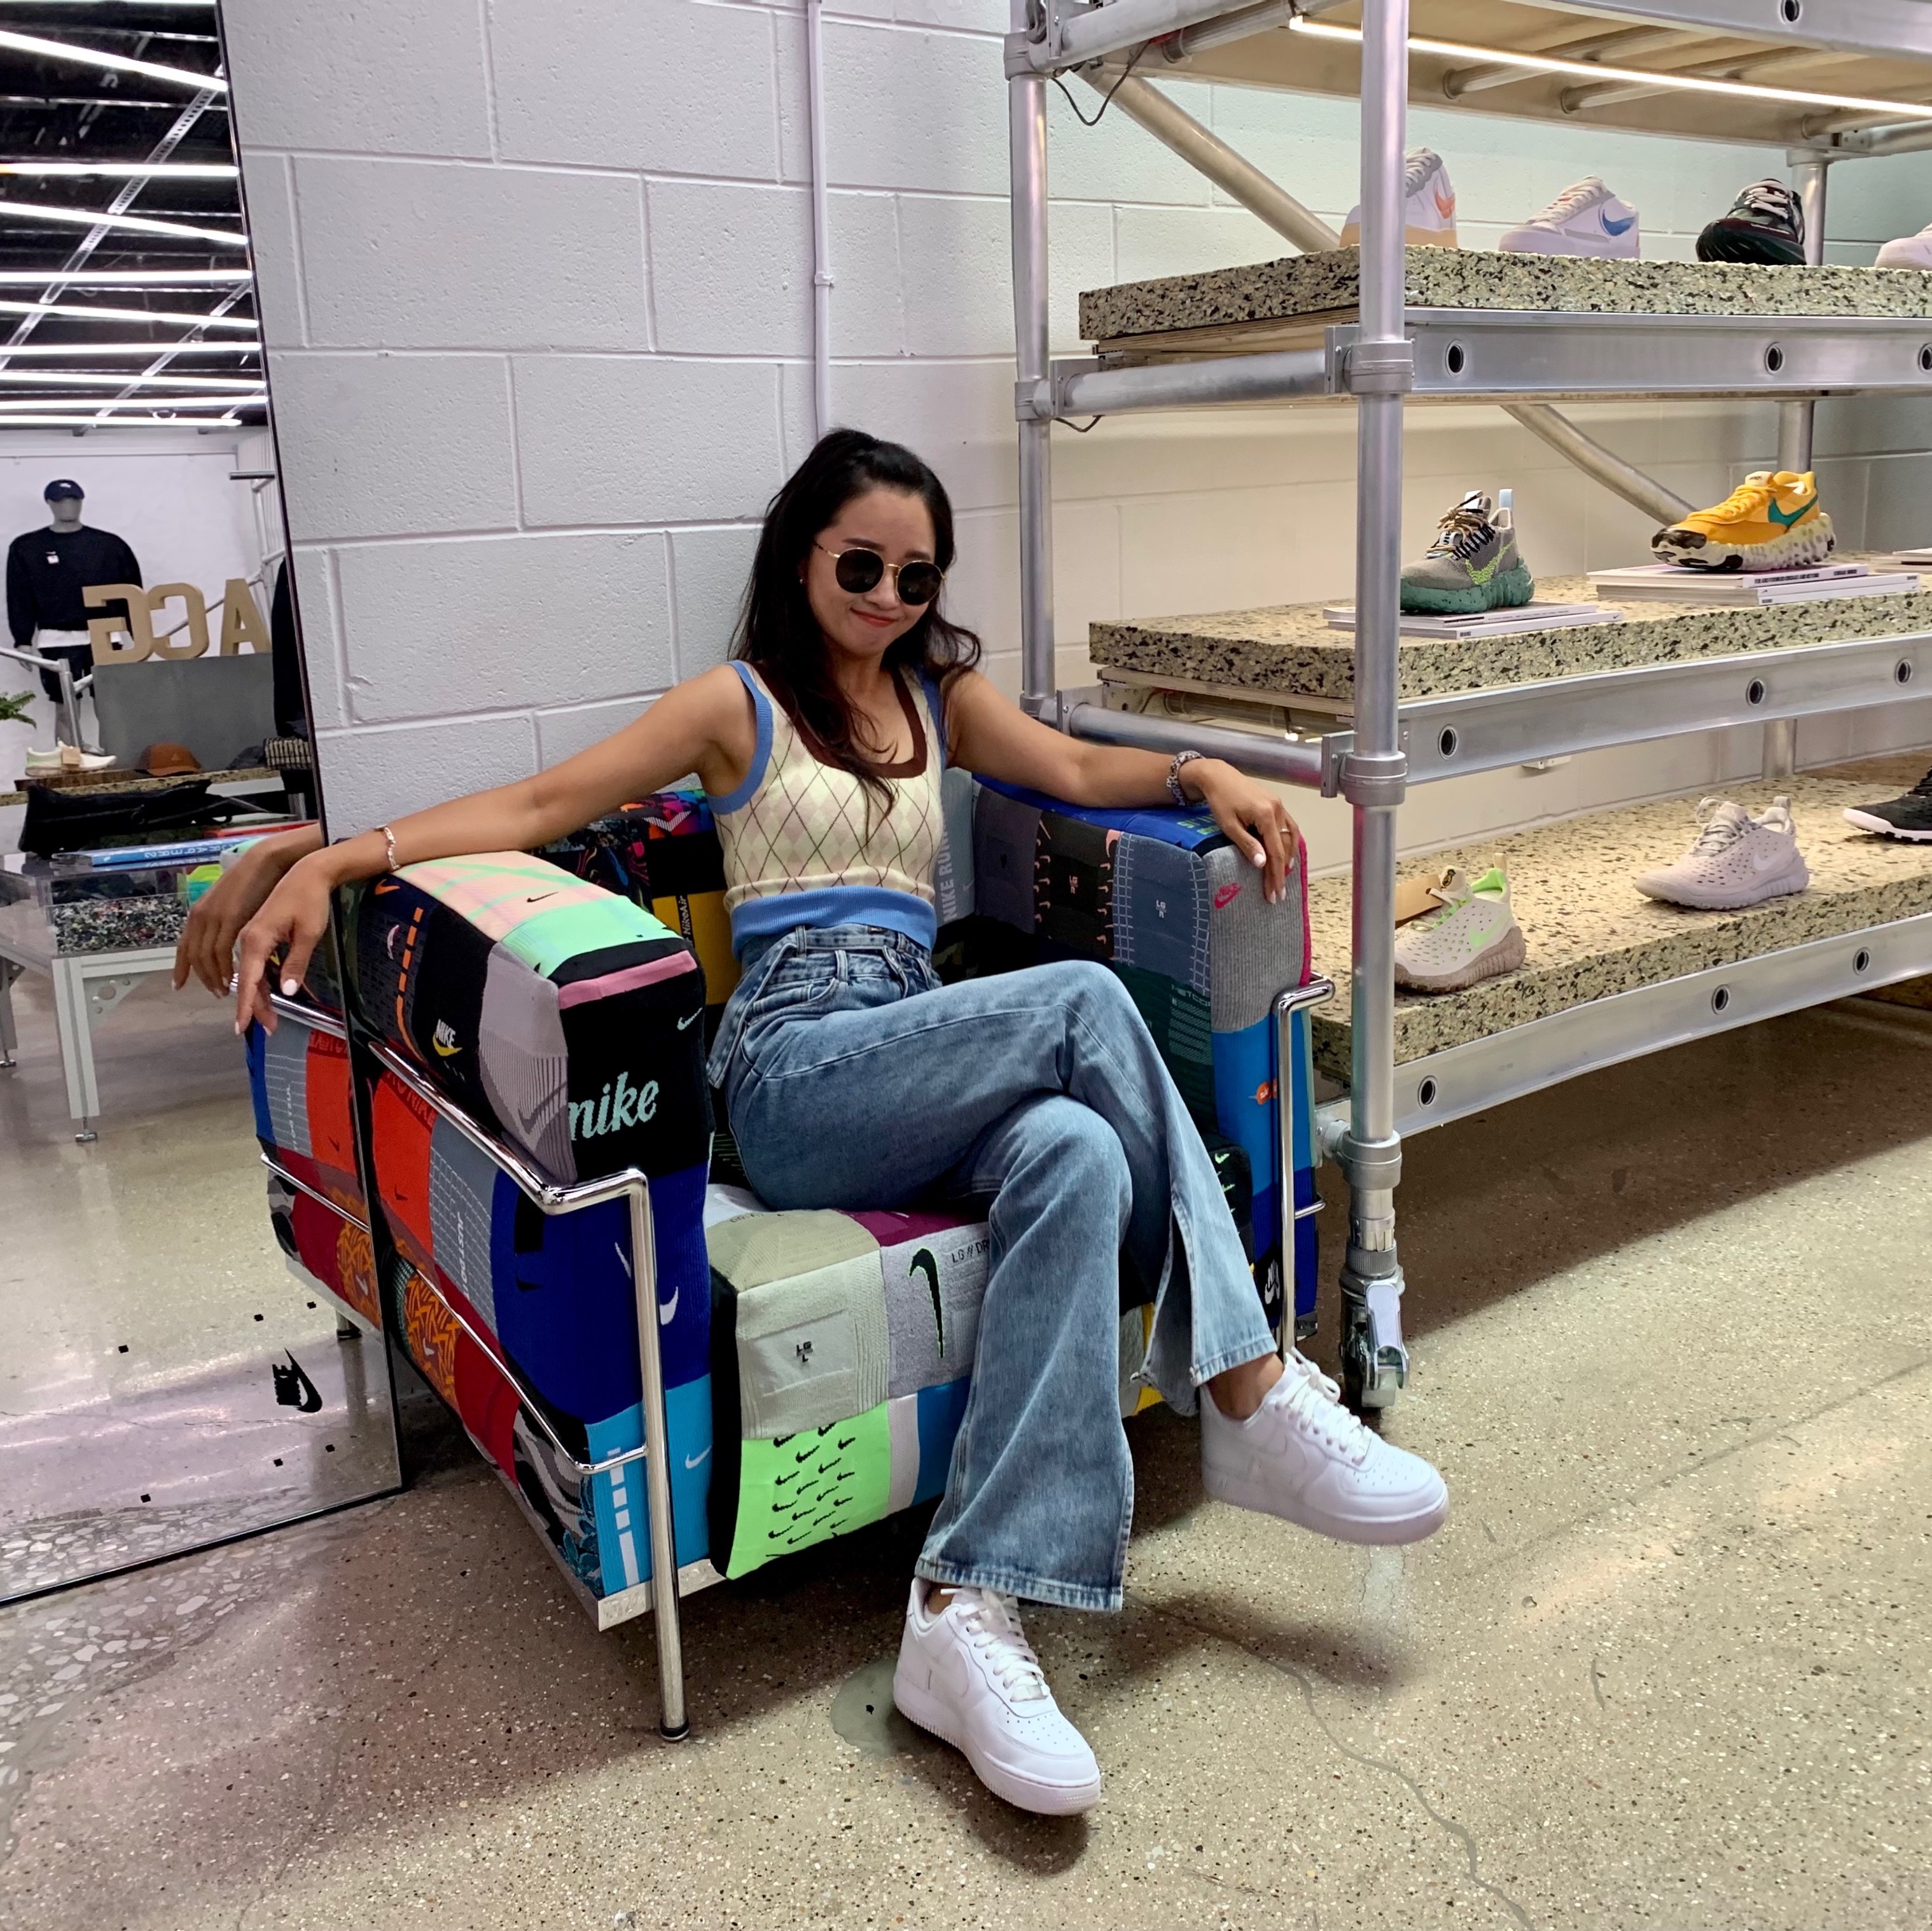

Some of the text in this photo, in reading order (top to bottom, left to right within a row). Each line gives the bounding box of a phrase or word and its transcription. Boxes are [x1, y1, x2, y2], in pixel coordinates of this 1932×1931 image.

[940, 878, 957, 922] NIKE
[1156, 899, 1166, 910] LG
[1158, 910, 1164, 919] R
[435, 1018, 456, 1049] NIKE
[568, 1071, 659, 1141] nike
[951, 1249, 965, 1263] LG
[796, 1341, 812, 1353] LG
[802, 1354, 809, 1363] L
